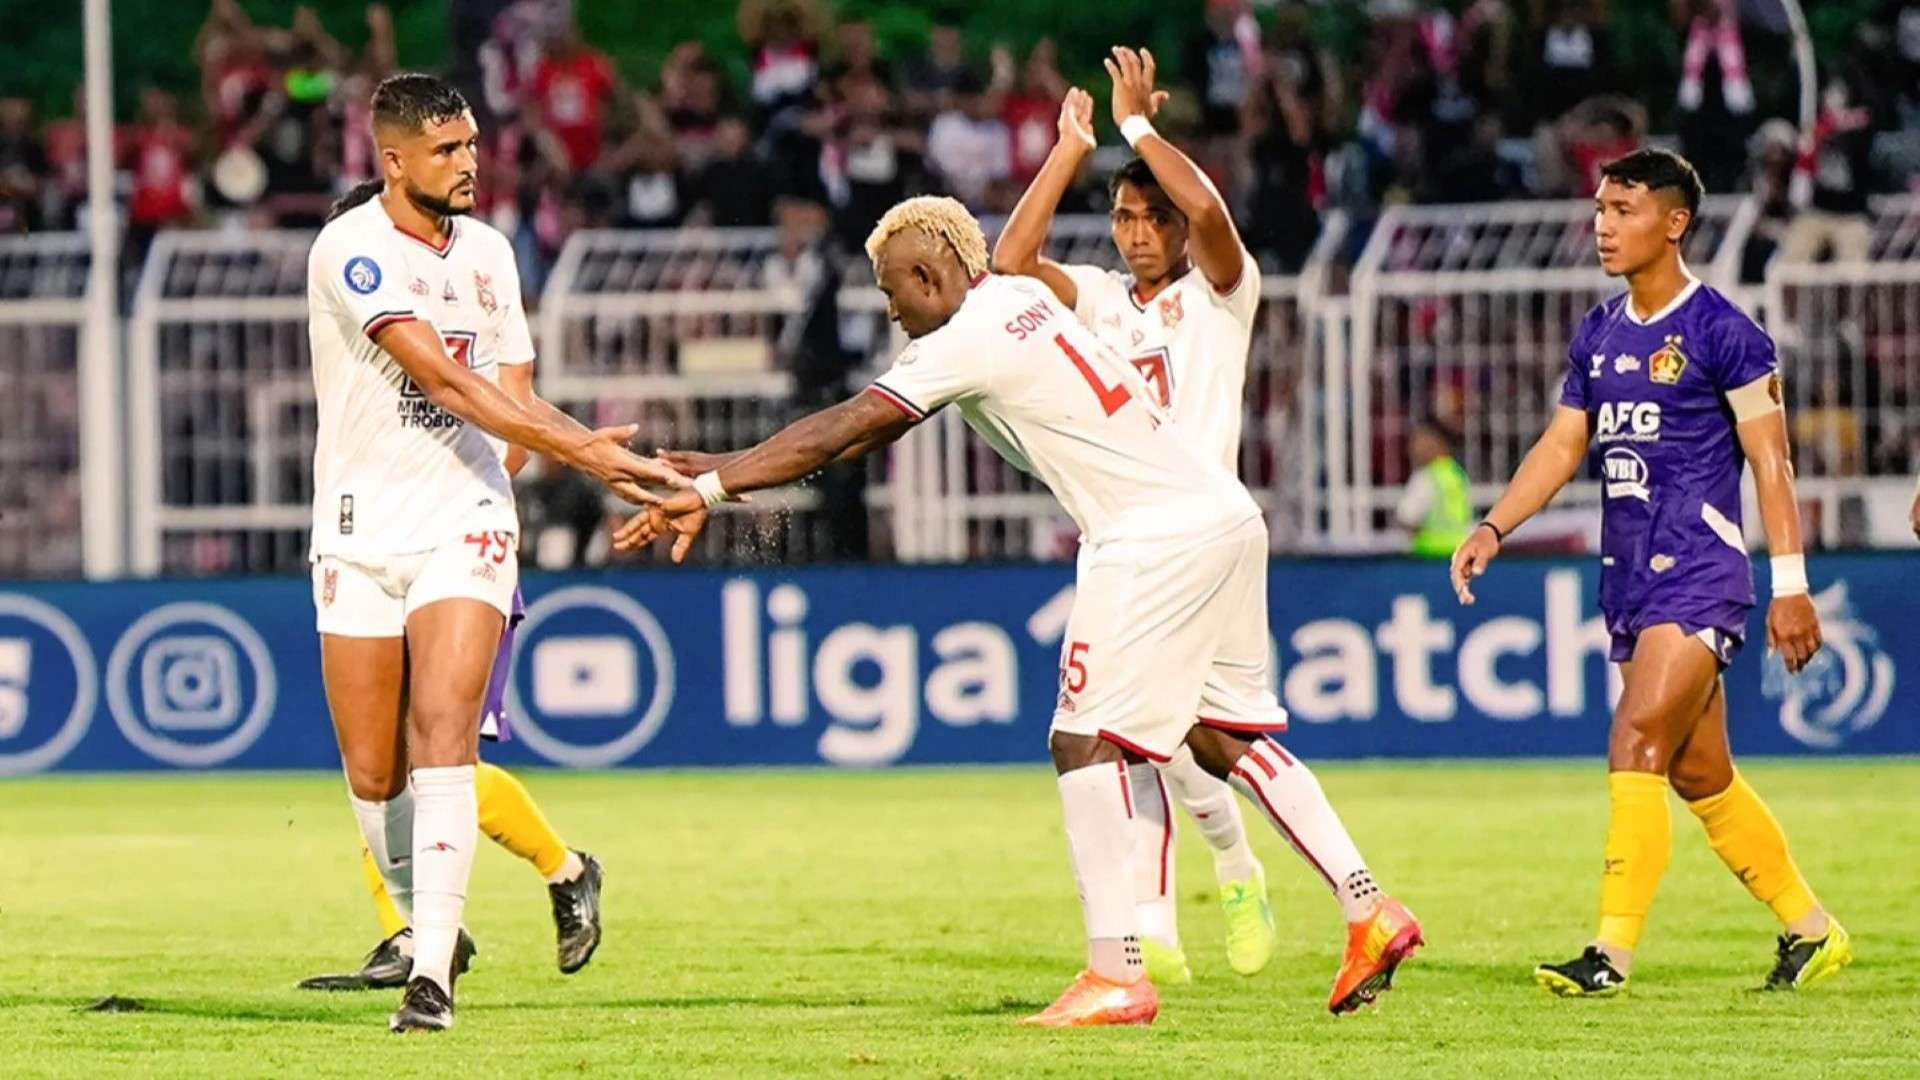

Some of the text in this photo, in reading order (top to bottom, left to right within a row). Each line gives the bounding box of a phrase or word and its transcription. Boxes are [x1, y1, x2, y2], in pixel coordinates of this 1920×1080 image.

[1005, 299, 1055, 341] SONY
[1597, 402, 1661, 434] AFG
[1605, 458, 1638, 480] WBI
[464, 530, 509, 564] 49
[721, 567, 1625, 767] liga atch
